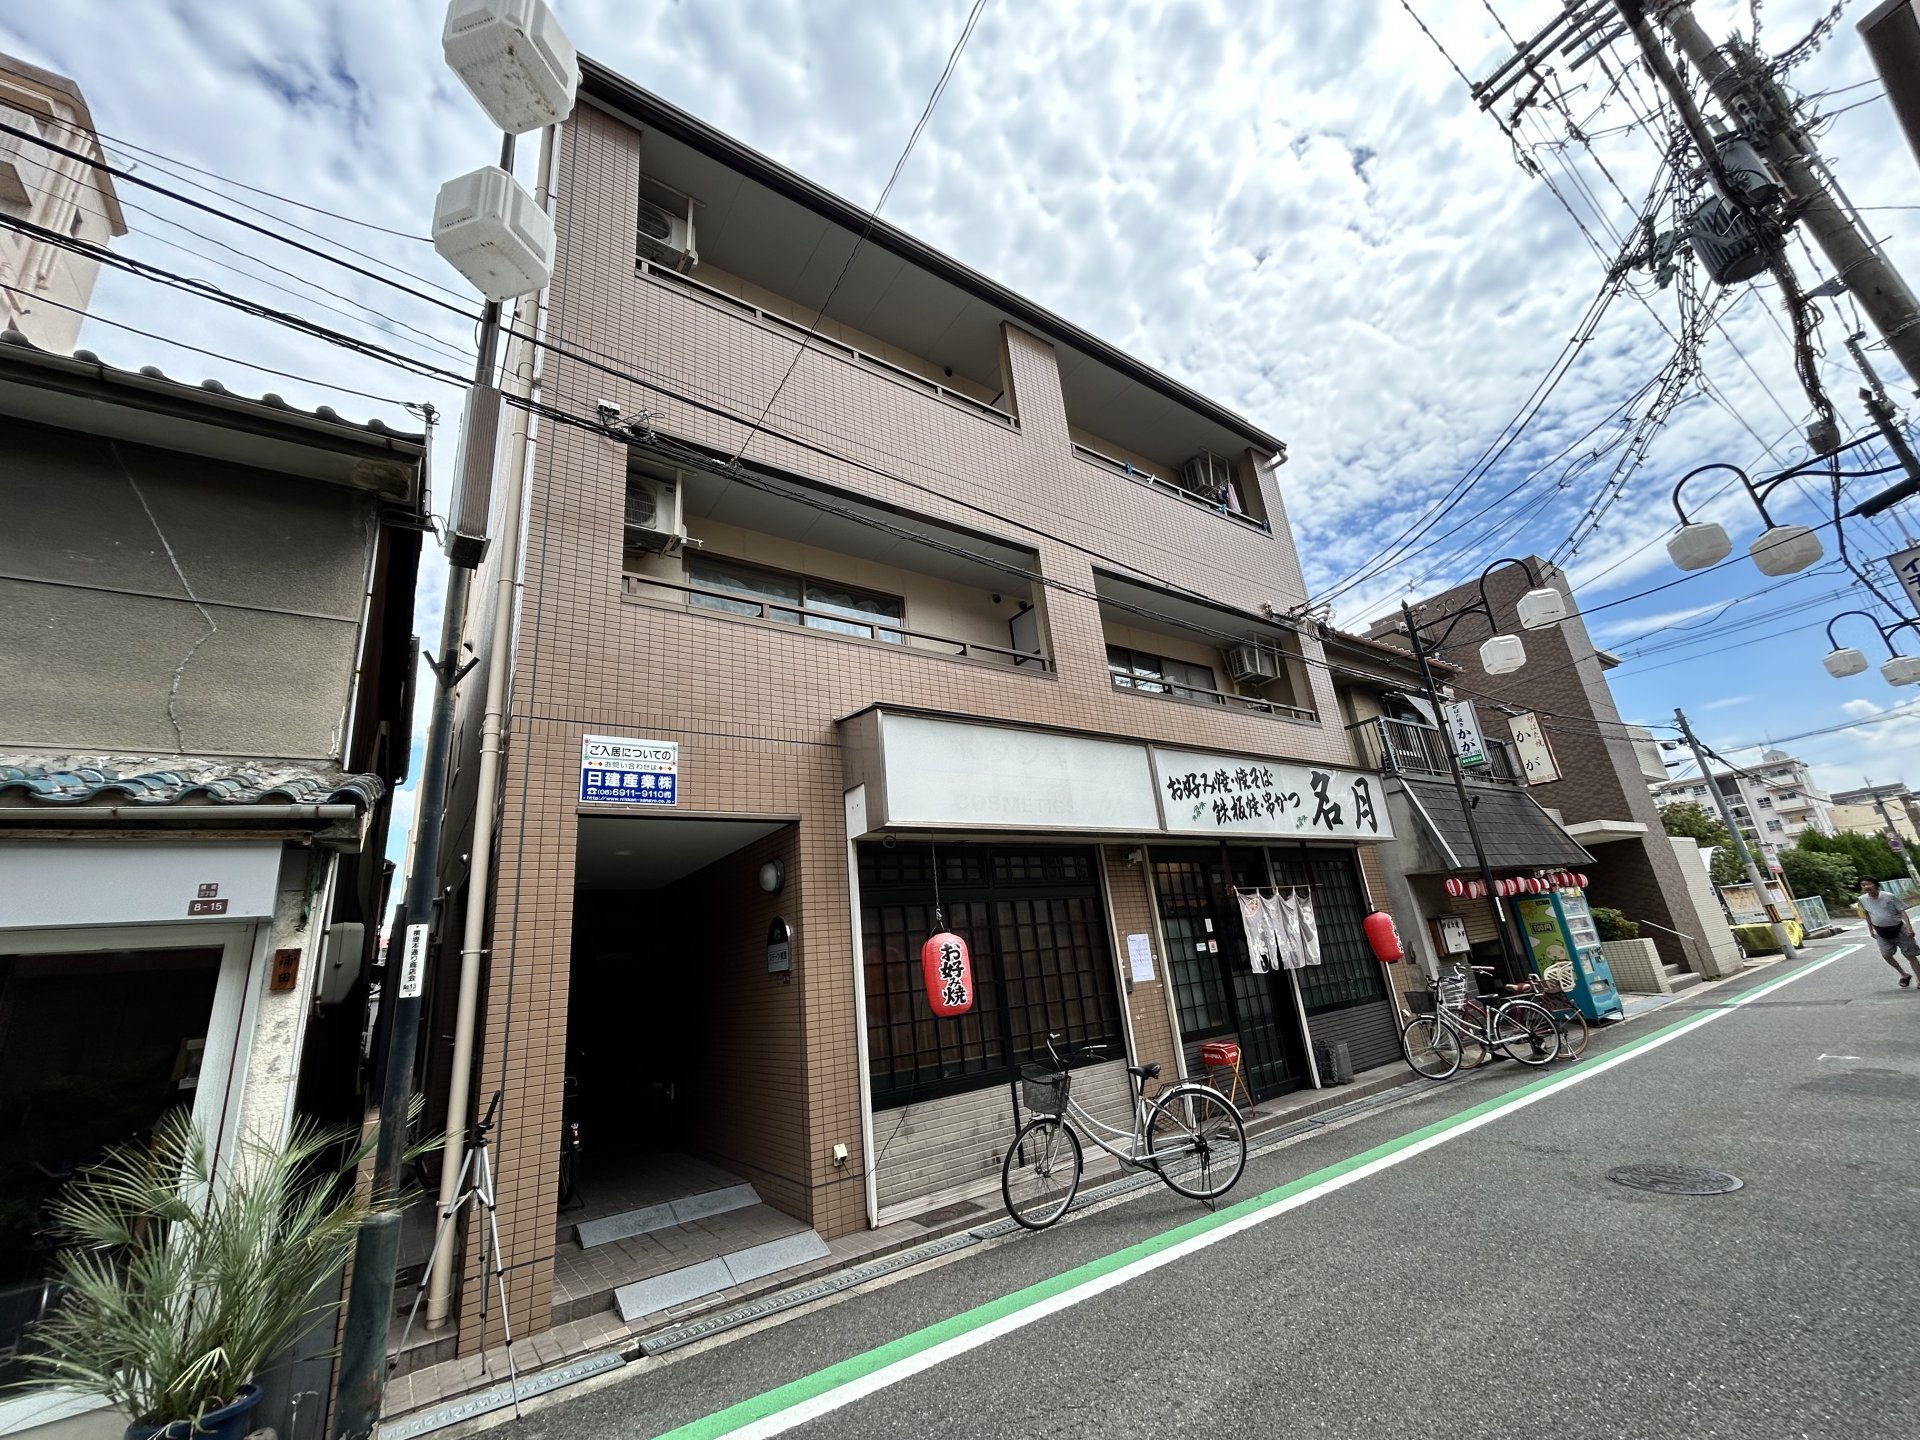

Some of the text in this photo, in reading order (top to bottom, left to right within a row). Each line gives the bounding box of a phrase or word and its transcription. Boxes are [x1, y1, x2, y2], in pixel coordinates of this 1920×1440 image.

[1457, 729, 1476, 752] かが
[1516, 730, 1541, 771] かが
[589, 745, 672, 761] ご入居についての
[604, 761, 657, 771] お問い合わせは
[1309, 769, 1378, 834] 名月
[193, 902, 223, 912] 8-15
[940, 943, 967, 1005] お好み焼
